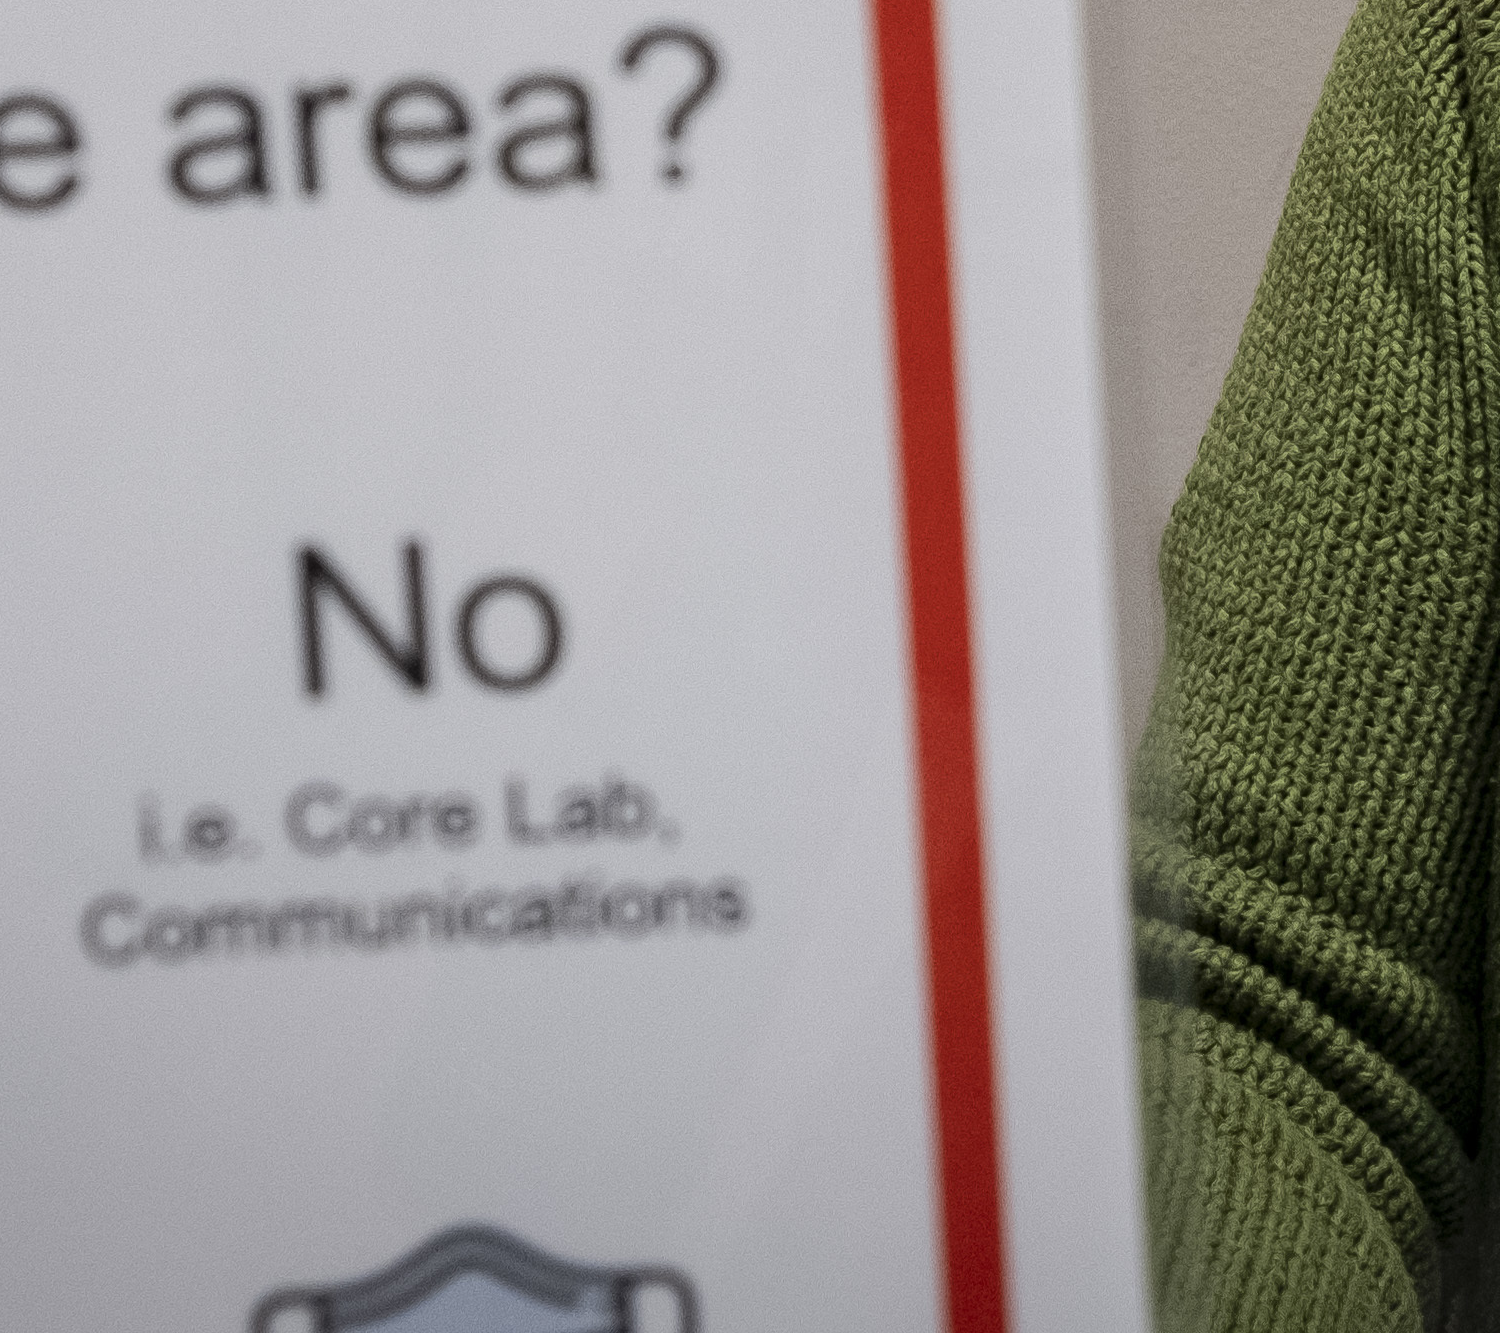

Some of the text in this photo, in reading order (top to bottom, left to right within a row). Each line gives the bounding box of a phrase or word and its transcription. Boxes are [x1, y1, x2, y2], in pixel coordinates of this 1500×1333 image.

[164, 23, 724, 207] area?
[290, 537, 568, 702] No
[138, 774, 678, 865] i.e. Core Lab,
[80, 874, 748, 969] Communications
